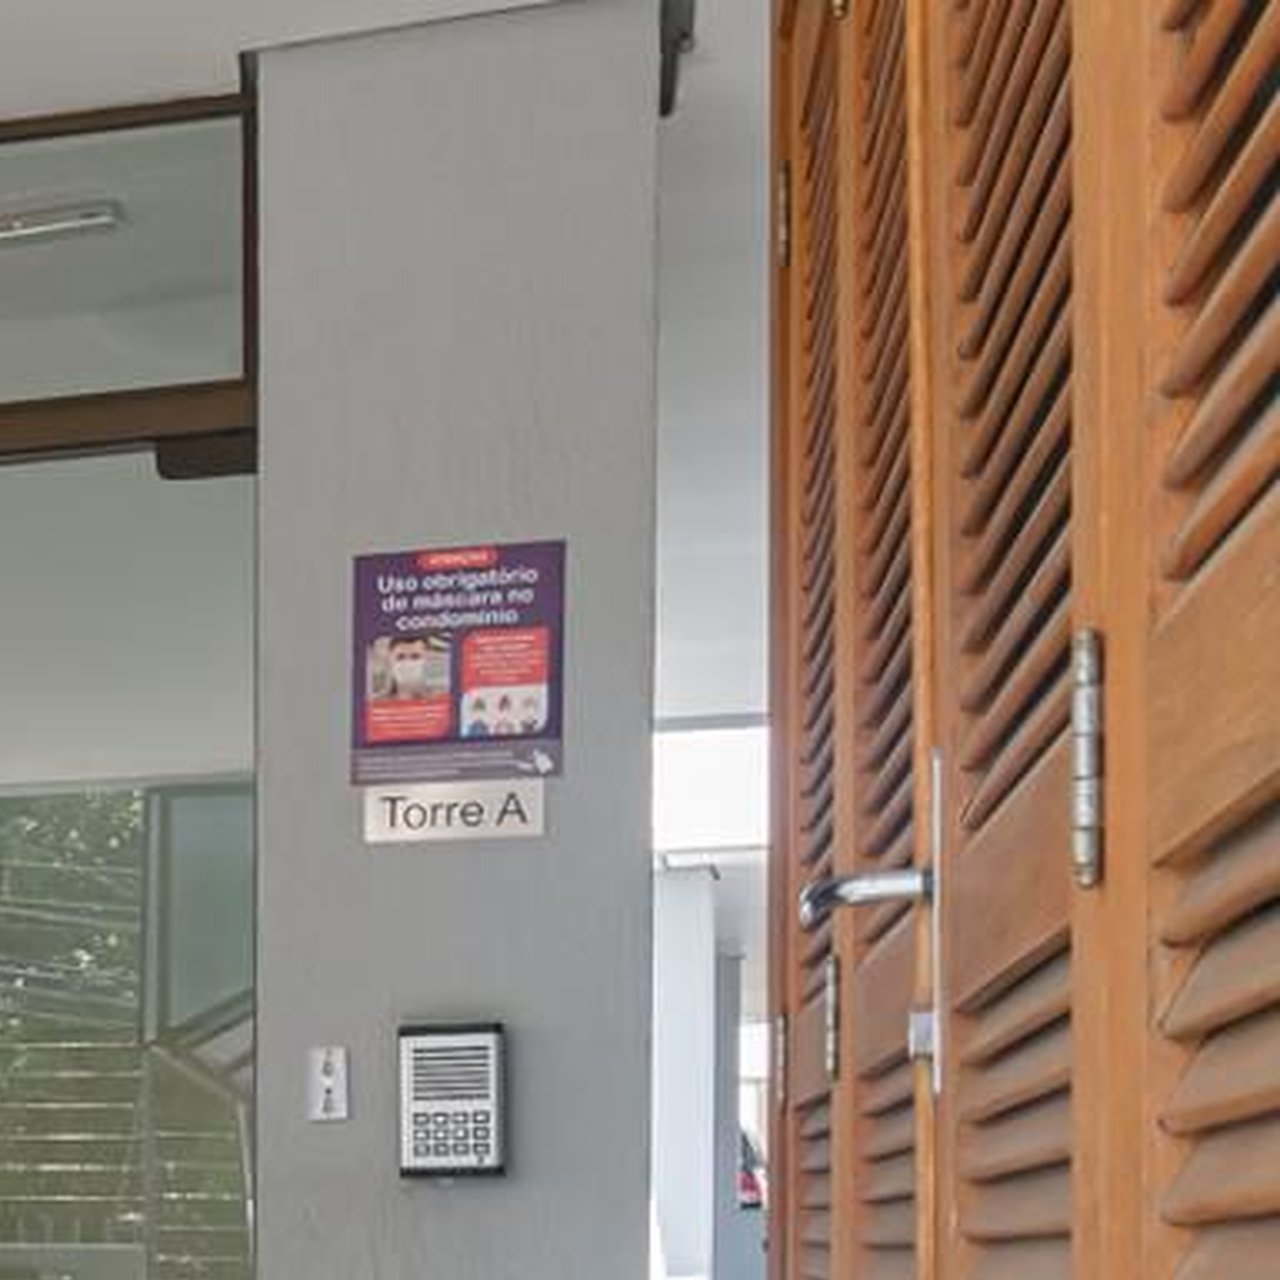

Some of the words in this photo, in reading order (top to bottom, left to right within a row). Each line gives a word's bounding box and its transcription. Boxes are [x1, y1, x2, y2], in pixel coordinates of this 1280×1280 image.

[377, 575, 418, 594] Uso
[422, 564, 538, 590] obrigatório
[381, 595, 408, 612] de
[413, 590, 502, 610] máscara
[507, 588, 534, 603] no
[395, 608, 520, 631] condomínio
[381, 795, 484, 829] Torre
[496, 792, 528, 827] A
